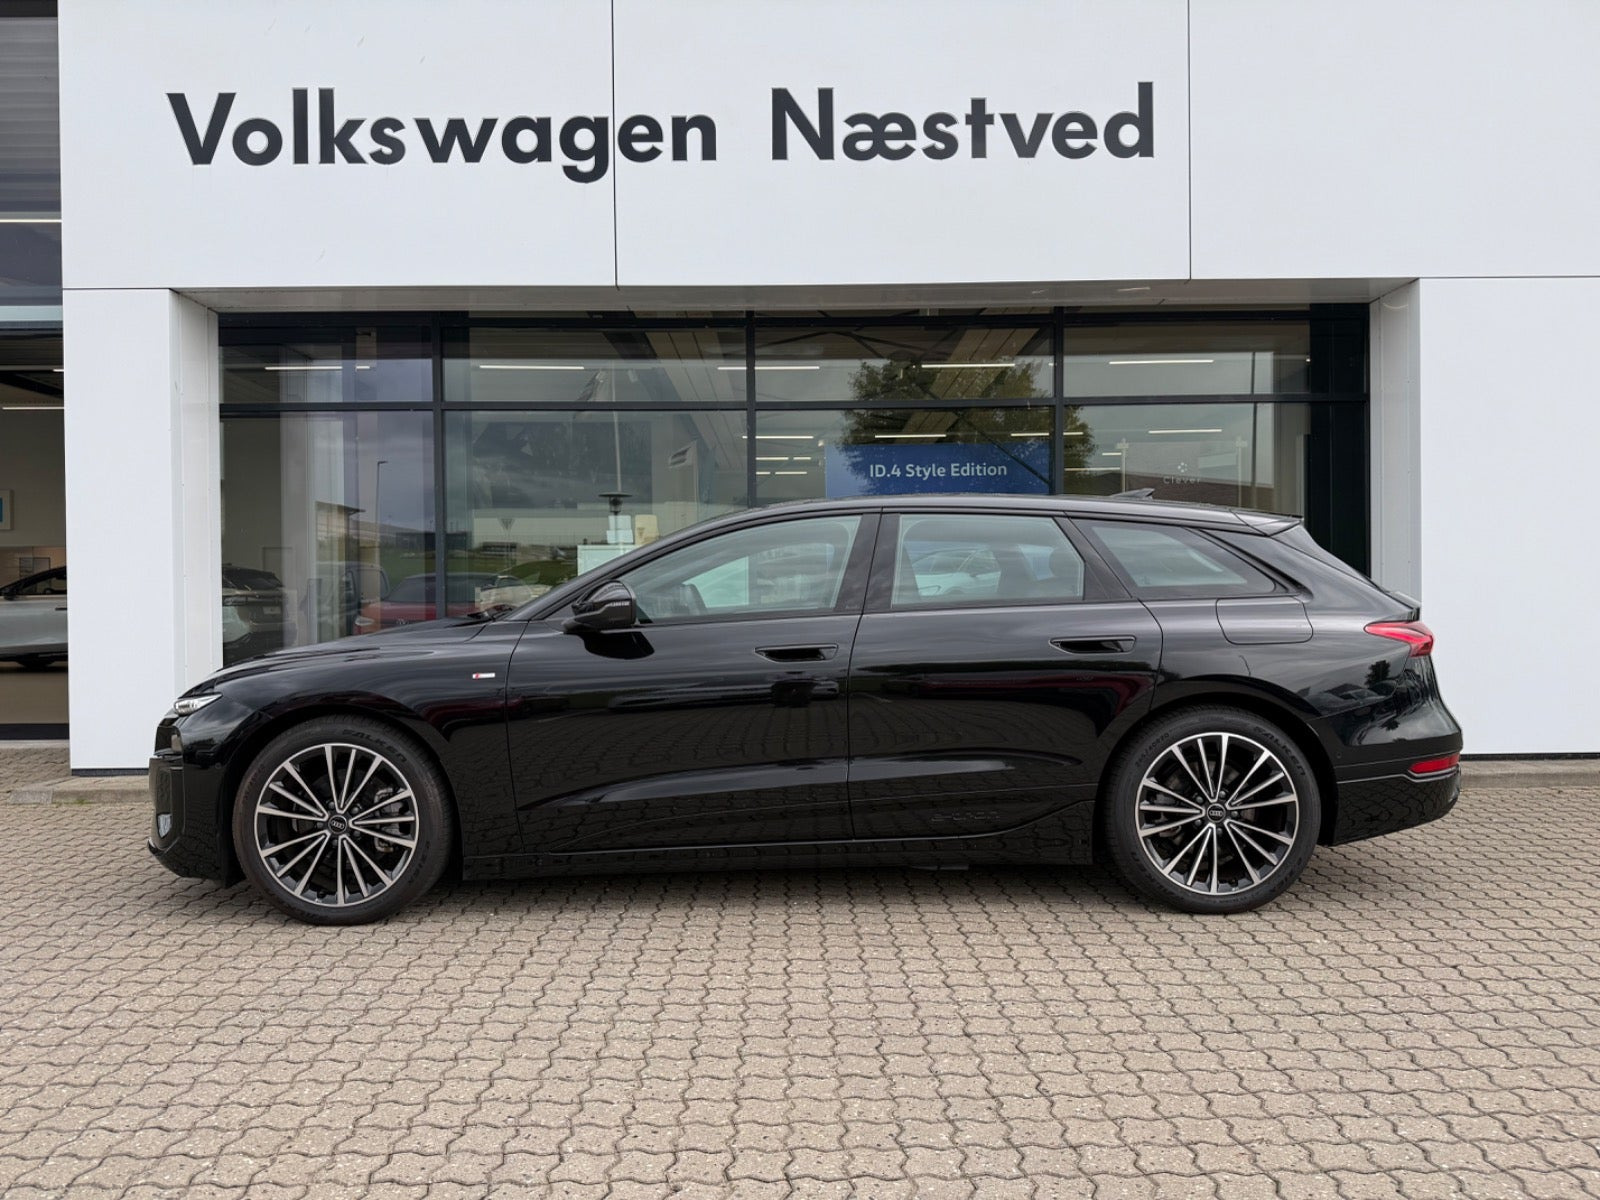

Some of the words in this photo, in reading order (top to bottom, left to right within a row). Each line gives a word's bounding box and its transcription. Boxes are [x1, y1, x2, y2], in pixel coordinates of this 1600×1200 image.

[167, 89, 716, 183] Volkswagen
[772, 82, 1153, 161] Næstved
[869, 464, 901, 478] ID.4
[905, 463, 946, 480] Style
[950, 462, 1007, 477] Edition
